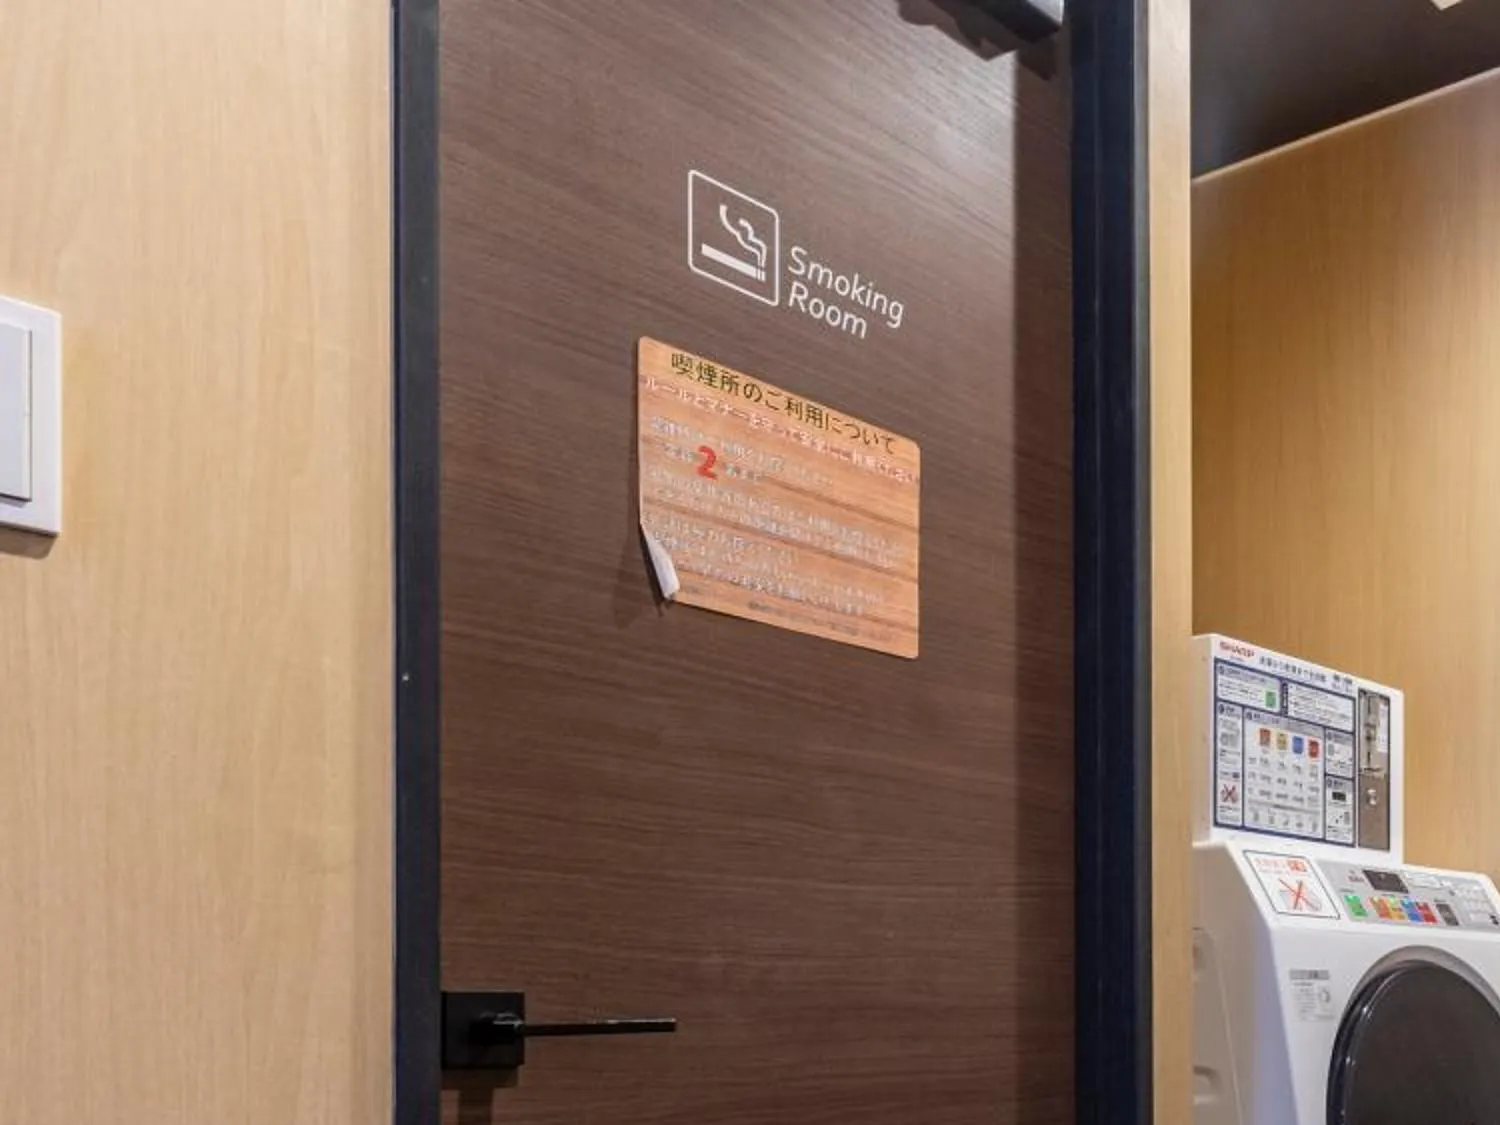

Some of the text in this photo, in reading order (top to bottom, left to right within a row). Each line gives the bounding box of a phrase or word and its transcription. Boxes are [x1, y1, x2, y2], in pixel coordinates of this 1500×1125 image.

[788, 246, 904, 328] Smoking
[788, 281, 867, 339] Room
[671, 353, 896, 454] 喫煙所のご利用について
[696, 445, 717, 480] 2
